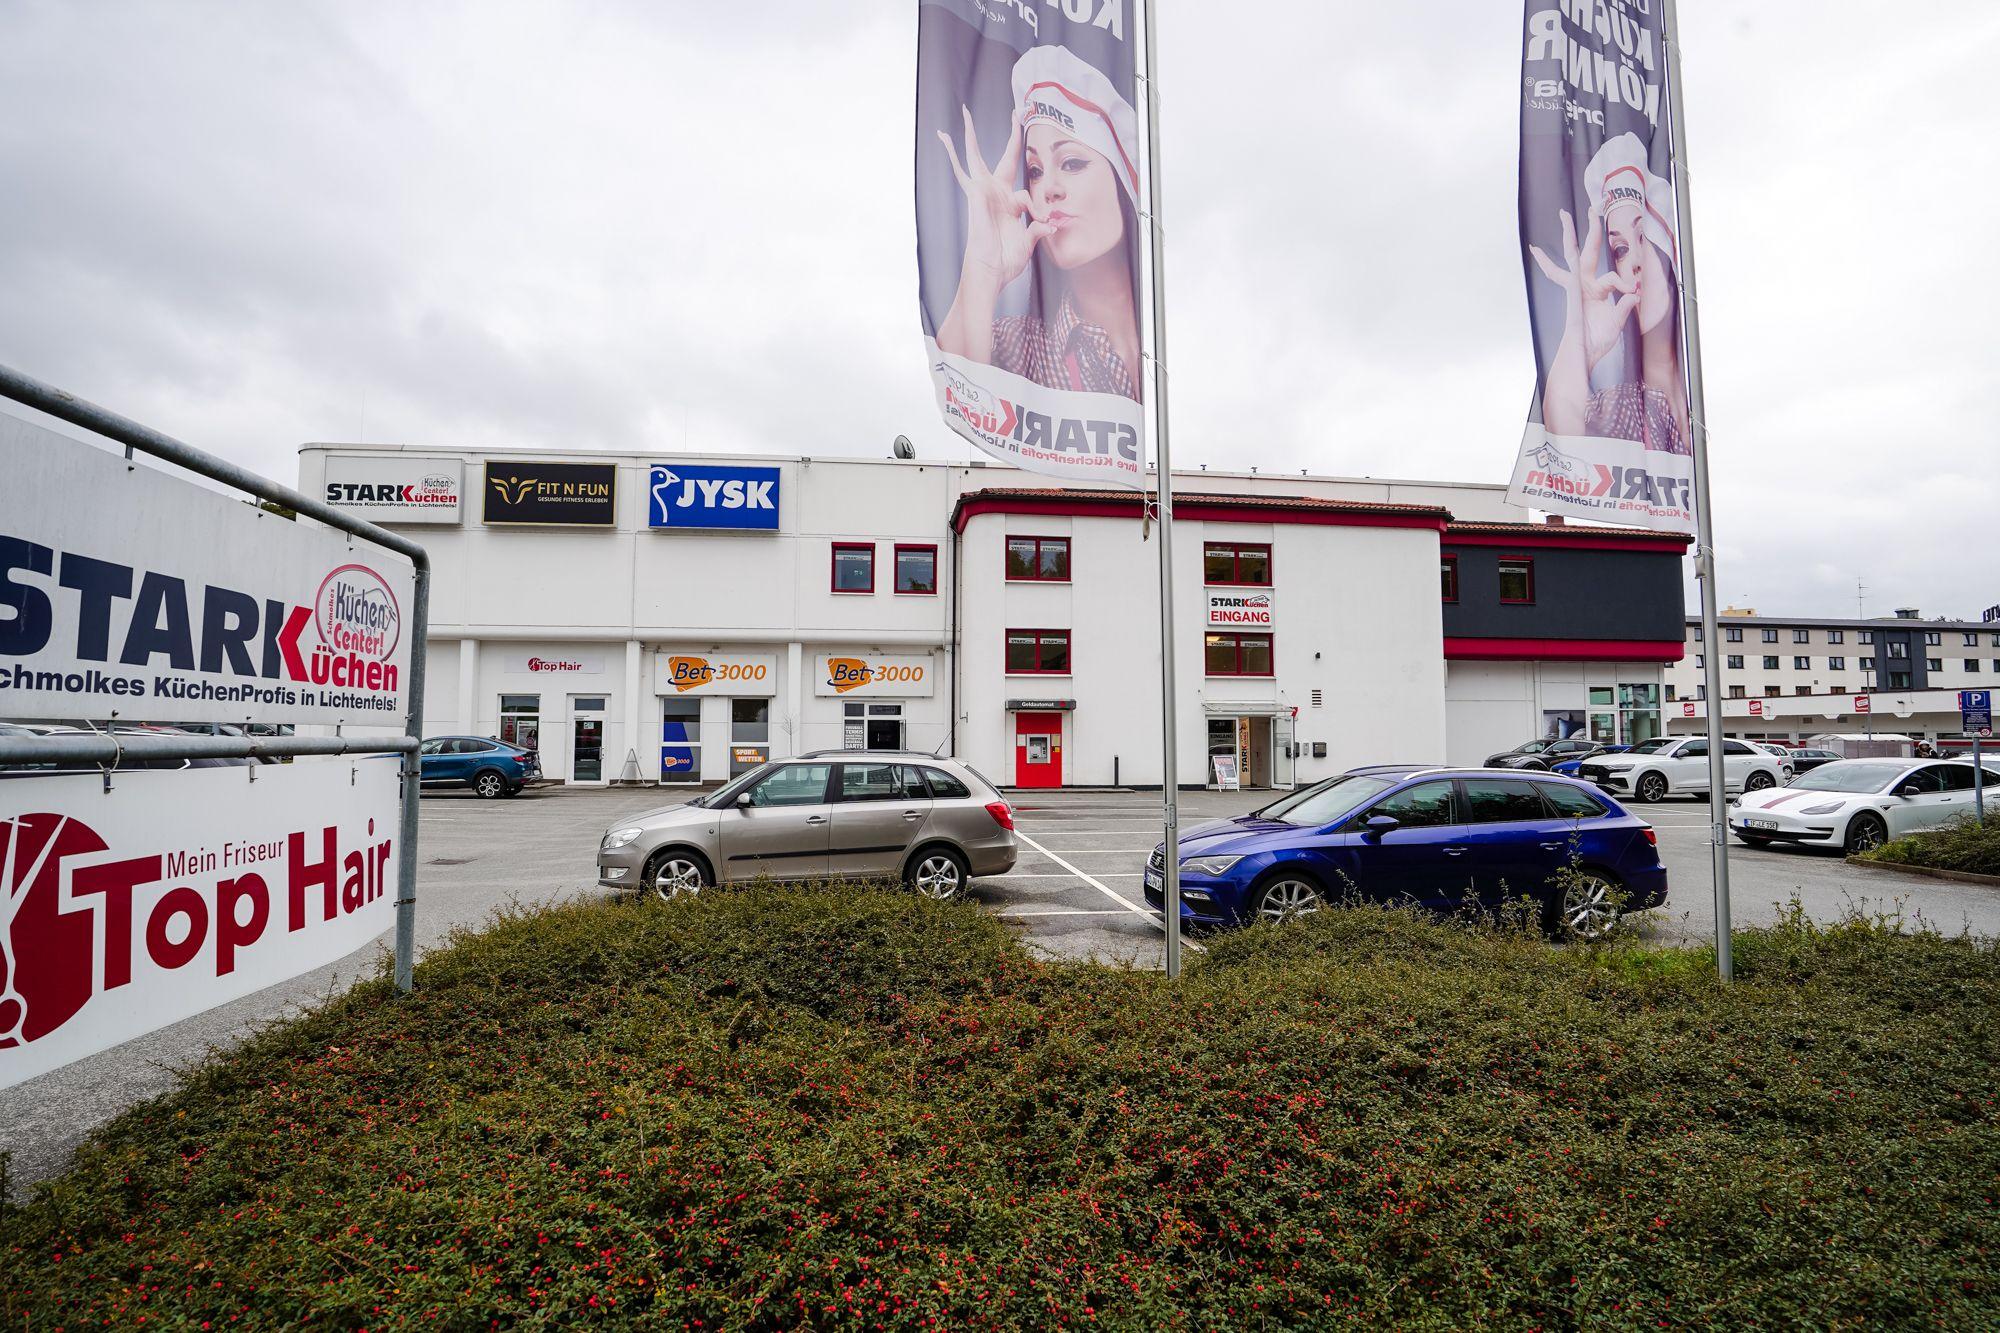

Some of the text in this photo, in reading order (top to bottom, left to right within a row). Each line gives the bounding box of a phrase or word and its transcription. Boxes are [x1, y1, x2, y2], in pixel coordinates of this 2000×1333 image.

[424, 478, 449, 488] Küchen
[537, 482, 609, 496] FIT N FUN
[675, 479, 775, 509] JYSK
[335, 581, 387, 630] Küchen
[1210, 610, 1270, 623] EINGANG
[333, 622, 385, 657] Center!
[538, 661, 582, 672] Top Hair
[674, 662, 767, 681] Bet 3000
[833, 663, 924, 682] Bet 3000
[0, 663, 397, 712] chmolkes KüchenProfis in Lichtenfels!
[735, 748, 756, 756] SPORT
[738, 755, 763, 763] WETTEN
[167, 840, 284, 880] Mein Friseur
[71, 817, 392, 992] Top Hair
